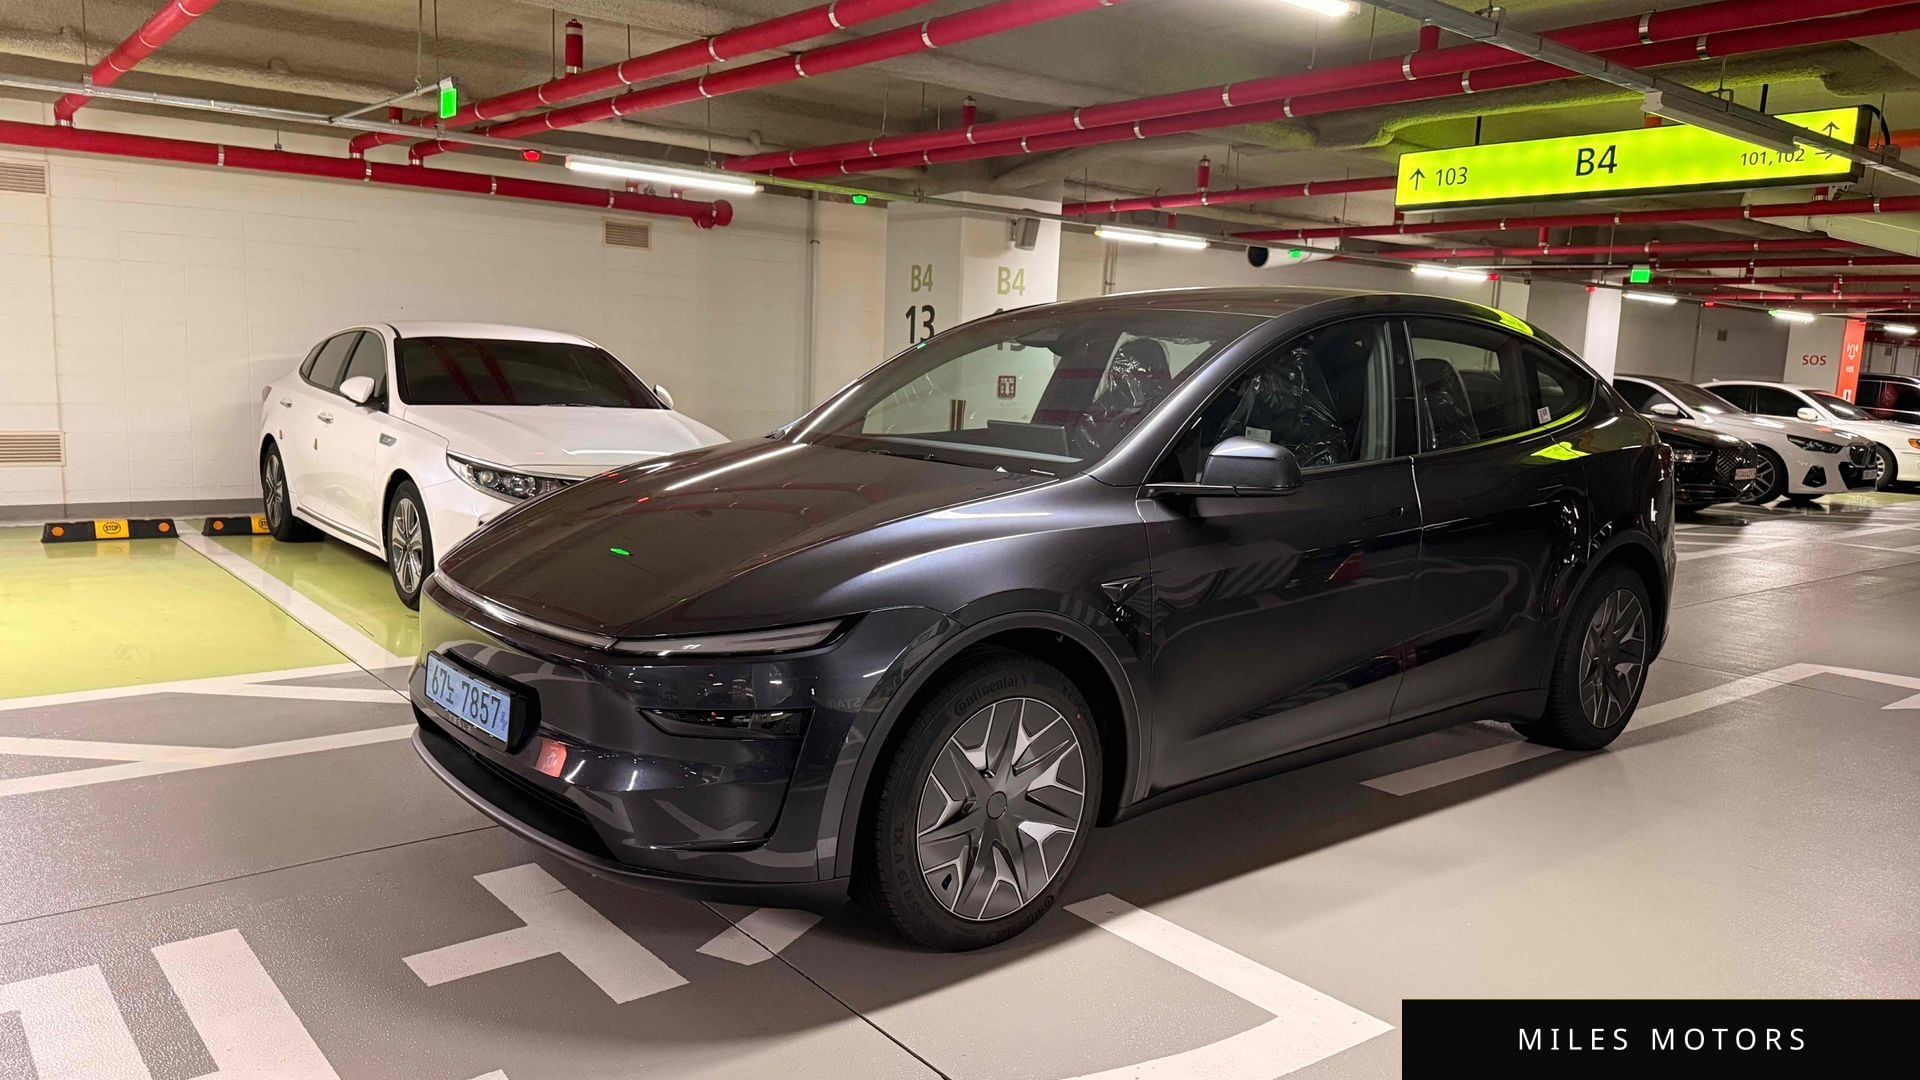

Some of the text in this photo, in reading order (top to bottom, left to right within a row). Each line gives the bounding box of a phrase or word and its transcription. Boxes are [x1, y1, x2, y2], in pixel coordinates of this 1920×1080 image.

[1575, 145, 1618, 177] B4
[1740, 148, 1805, 167] 101,102
[1434, 166, 1468, 187] 103
[911, 264, 934, 292] B4
[997, 266, 1025, 296] B4
[905, 305, 936, 344] 13
[1802, 354, 1827, 366] SOS
[105, 524, 119, 533] STOP
[431, 665, 501, 729] 67노 7857
